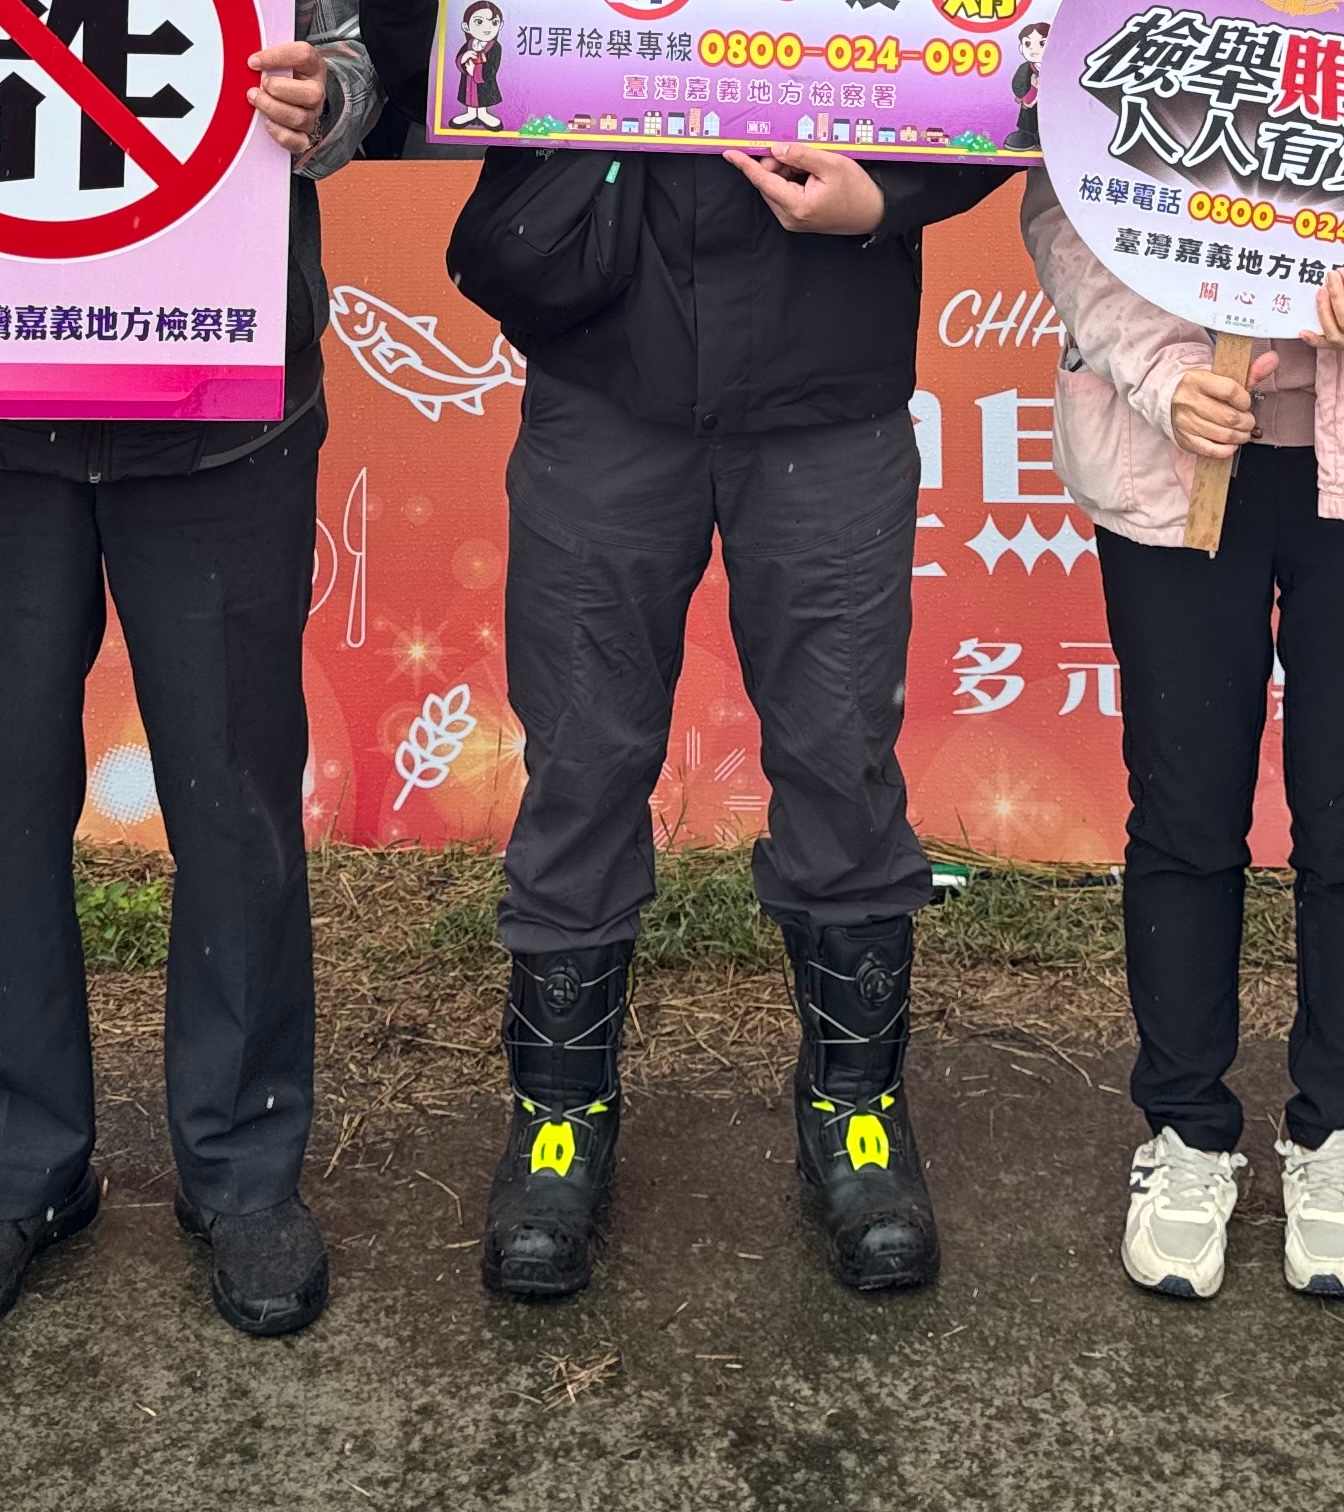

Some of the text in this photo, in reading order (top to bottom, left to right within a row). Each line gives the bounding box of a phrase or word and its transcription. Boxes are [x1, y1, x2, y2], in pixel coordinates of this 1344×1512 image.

[516, 25, 1003, 77] 犯罪檢舉專線 0800-024-099
[622, 73, 898, 111] 臺灣嘉義地方檢察署
[1078, 174, 1183, 217] 檢舉電話
[1198, 281, 1292, 315] 關心您
